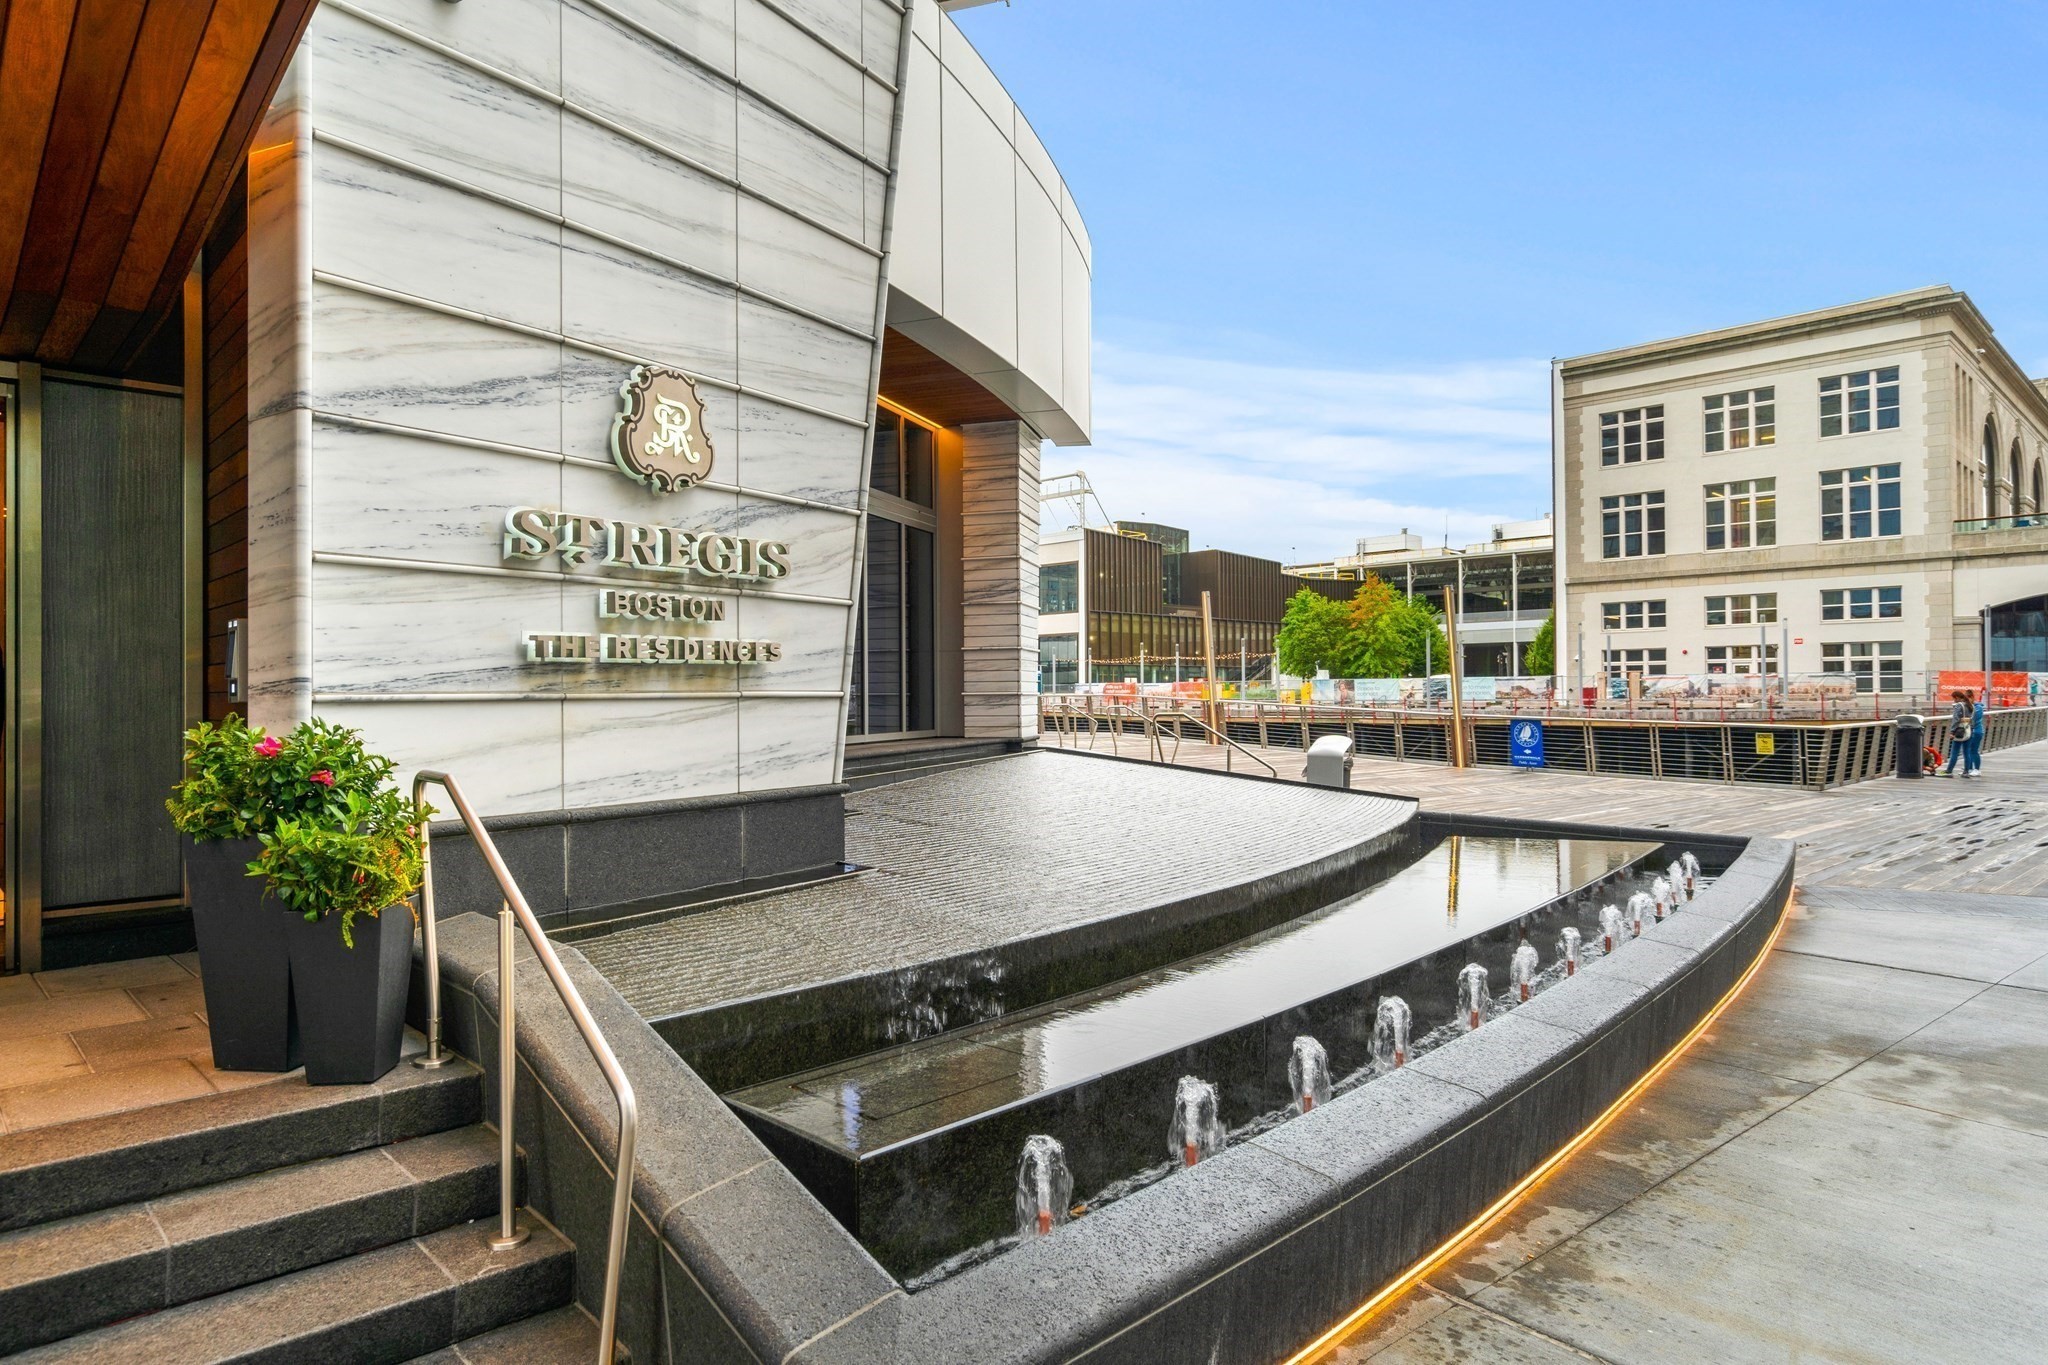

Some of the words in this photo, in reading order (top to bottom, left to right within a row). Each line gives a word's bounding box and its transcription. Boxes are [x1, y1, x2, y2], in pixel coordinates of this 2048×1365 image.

[603, 521, 791, 581] REGIS
[601, 590, 725, 621] BOSTON
[523, 631, 600, 662] THE
[602, 634, 782, 663] RESIDENCES
